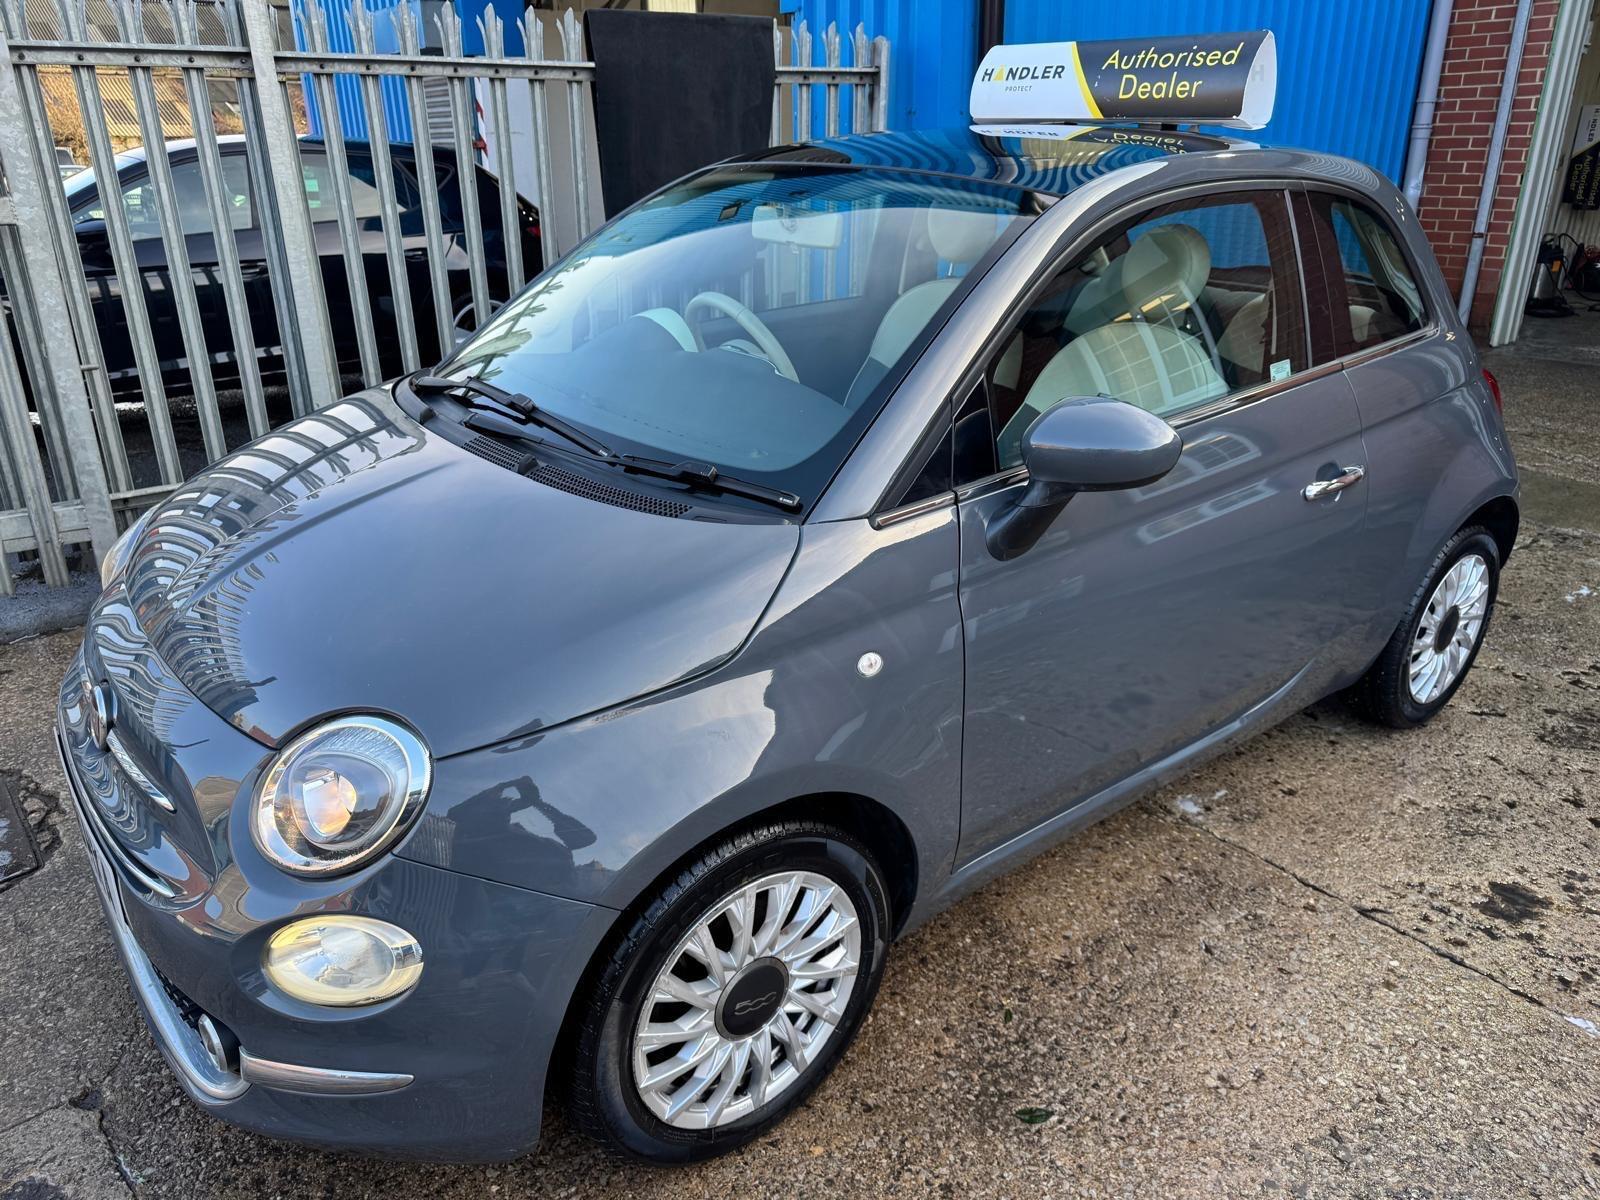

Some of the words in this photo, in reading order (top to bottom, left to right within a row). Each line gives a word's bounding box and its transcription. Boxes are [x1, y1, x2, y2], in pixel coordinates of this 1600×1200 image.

[1101, 42, 1244, 70] Authorised
[981, 65, 1065, 82] HANDLER
[1118, 72, 1202, 99] Dealer
